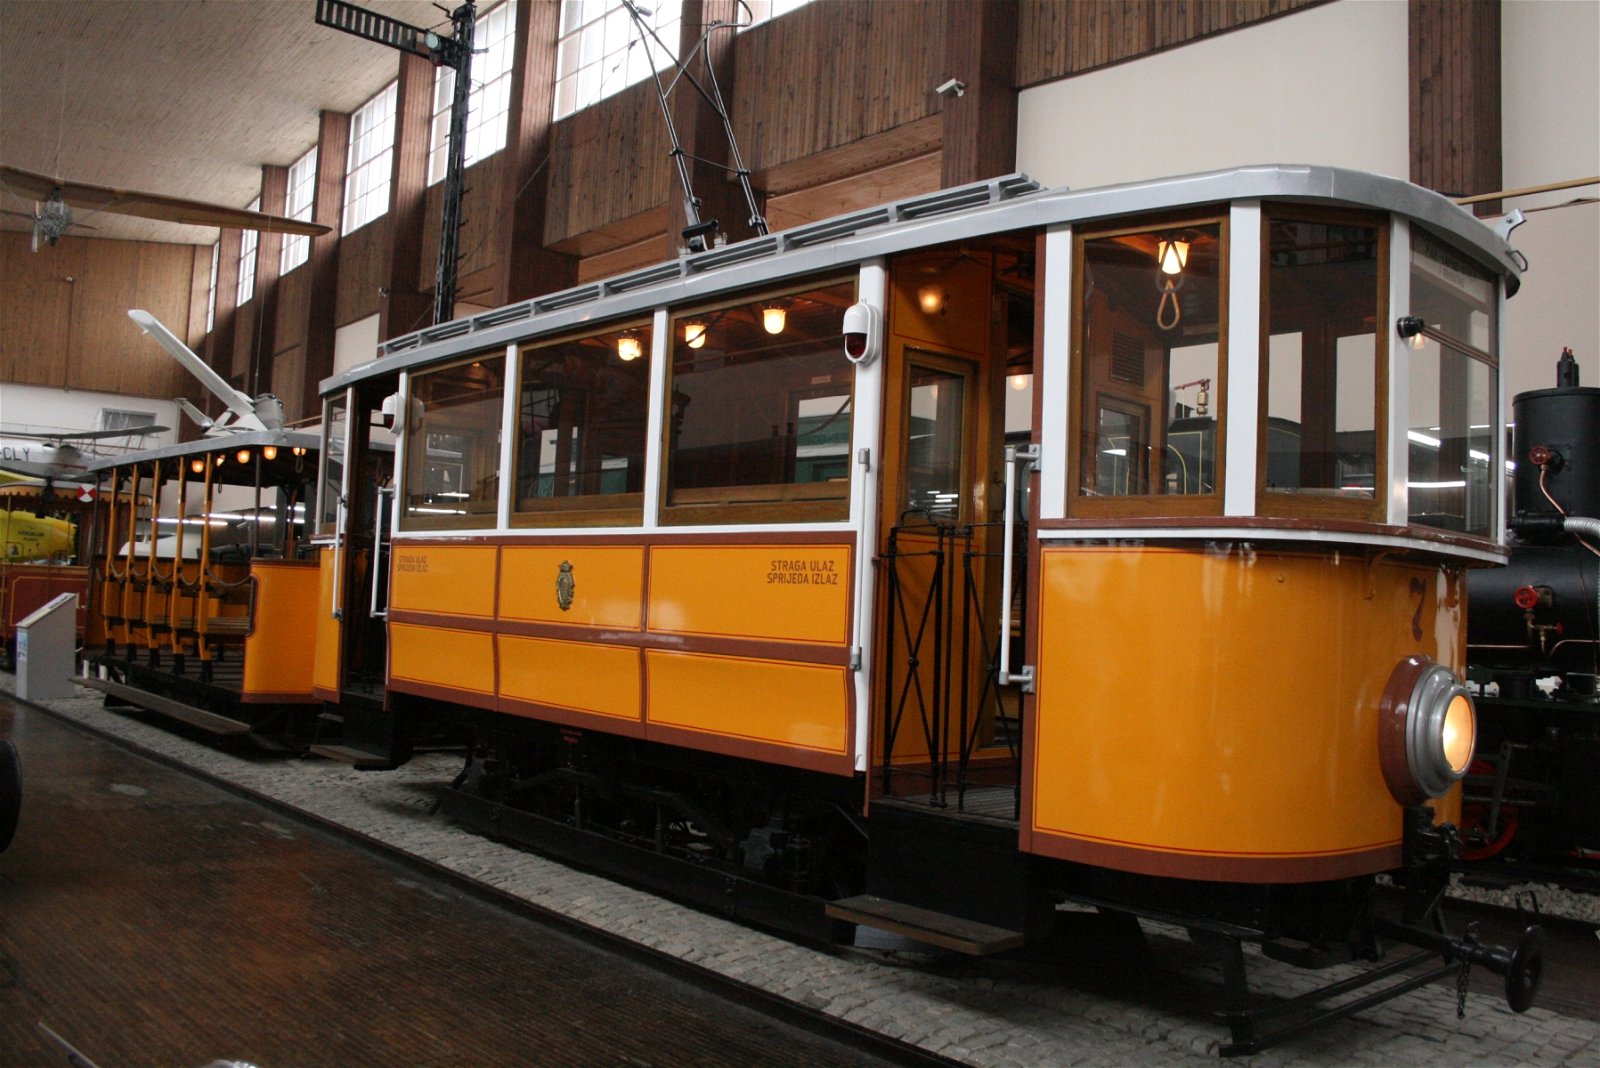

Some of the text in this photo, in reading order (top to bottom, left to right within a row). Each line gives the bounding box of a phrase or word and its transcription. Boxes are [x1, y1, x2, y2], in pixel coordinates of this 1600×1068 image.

[771, 560, 834, 572] STRAGA ULAZ
[767, 573, 838, 585] SPRIJEDA IZLAZ
[1409, 576, 1427, 642] 7
